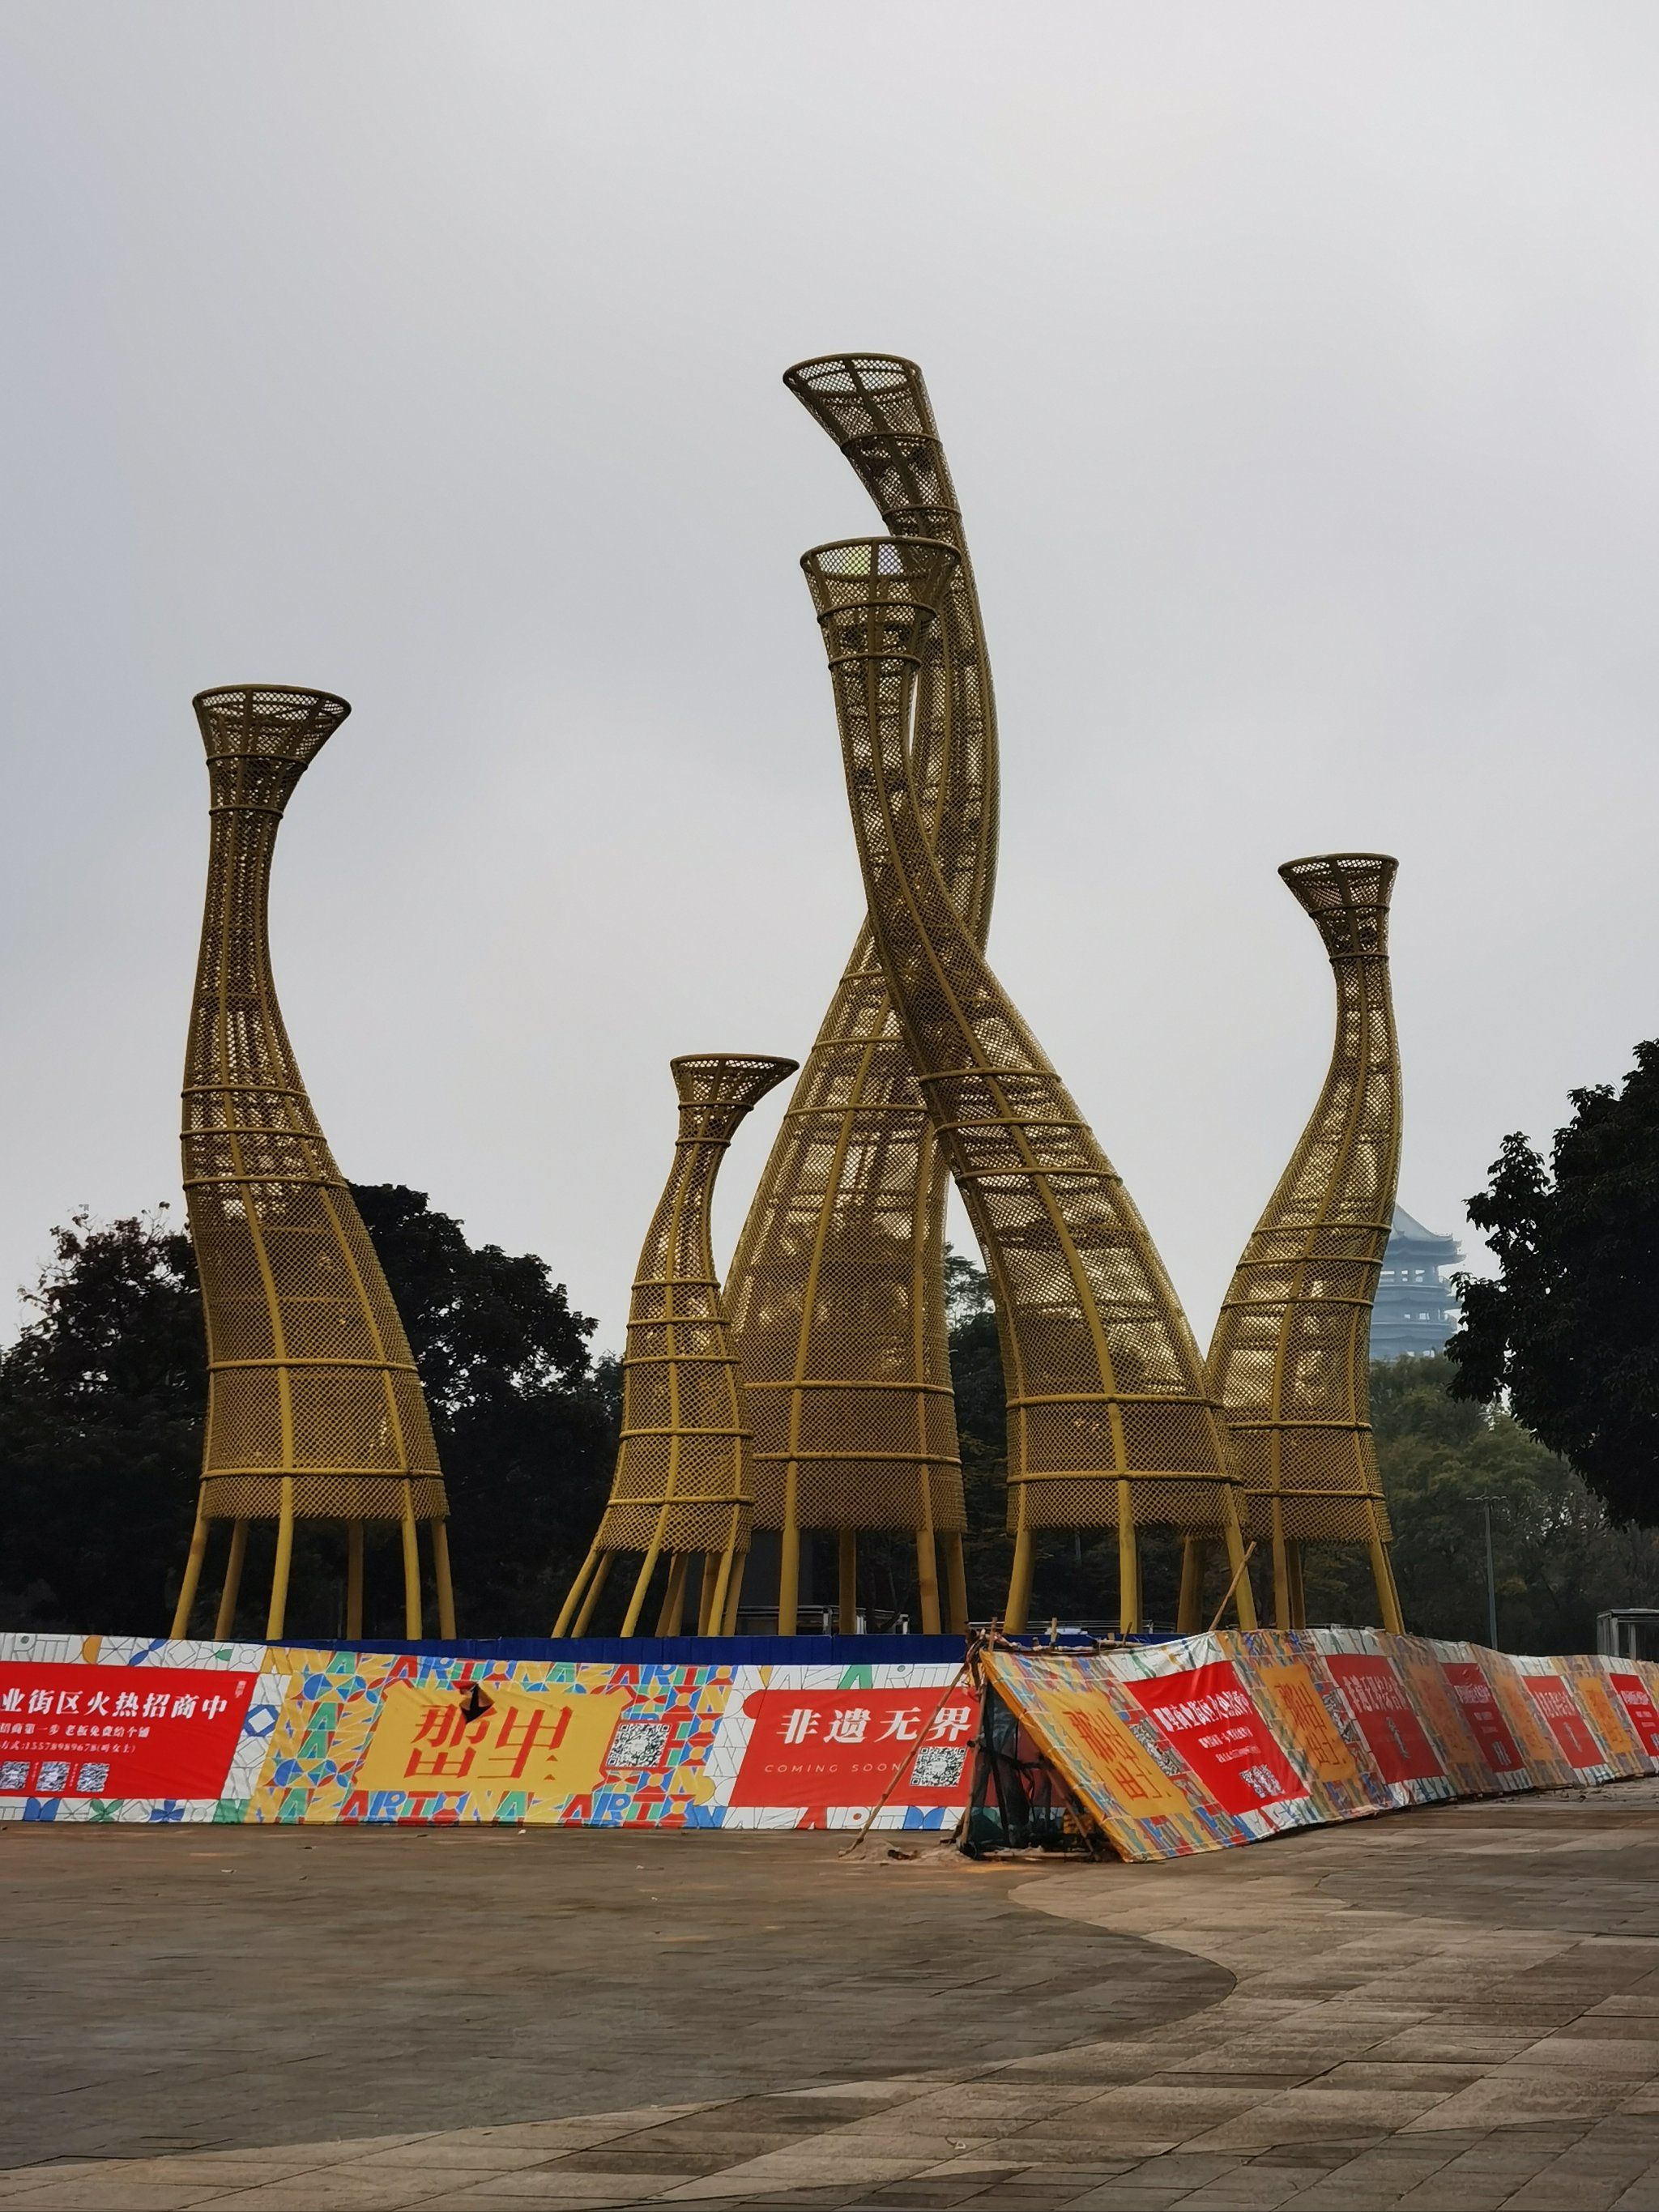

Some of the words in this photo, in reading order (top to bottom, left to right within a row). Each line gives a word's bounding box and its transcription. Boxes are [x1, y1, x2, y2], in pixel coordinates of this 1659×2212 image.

[776, 1707, 972, 1745] 非遗无界
[765, 1762, 839, 1774] COMING
[851, 1762, 902, 1773] SOON
